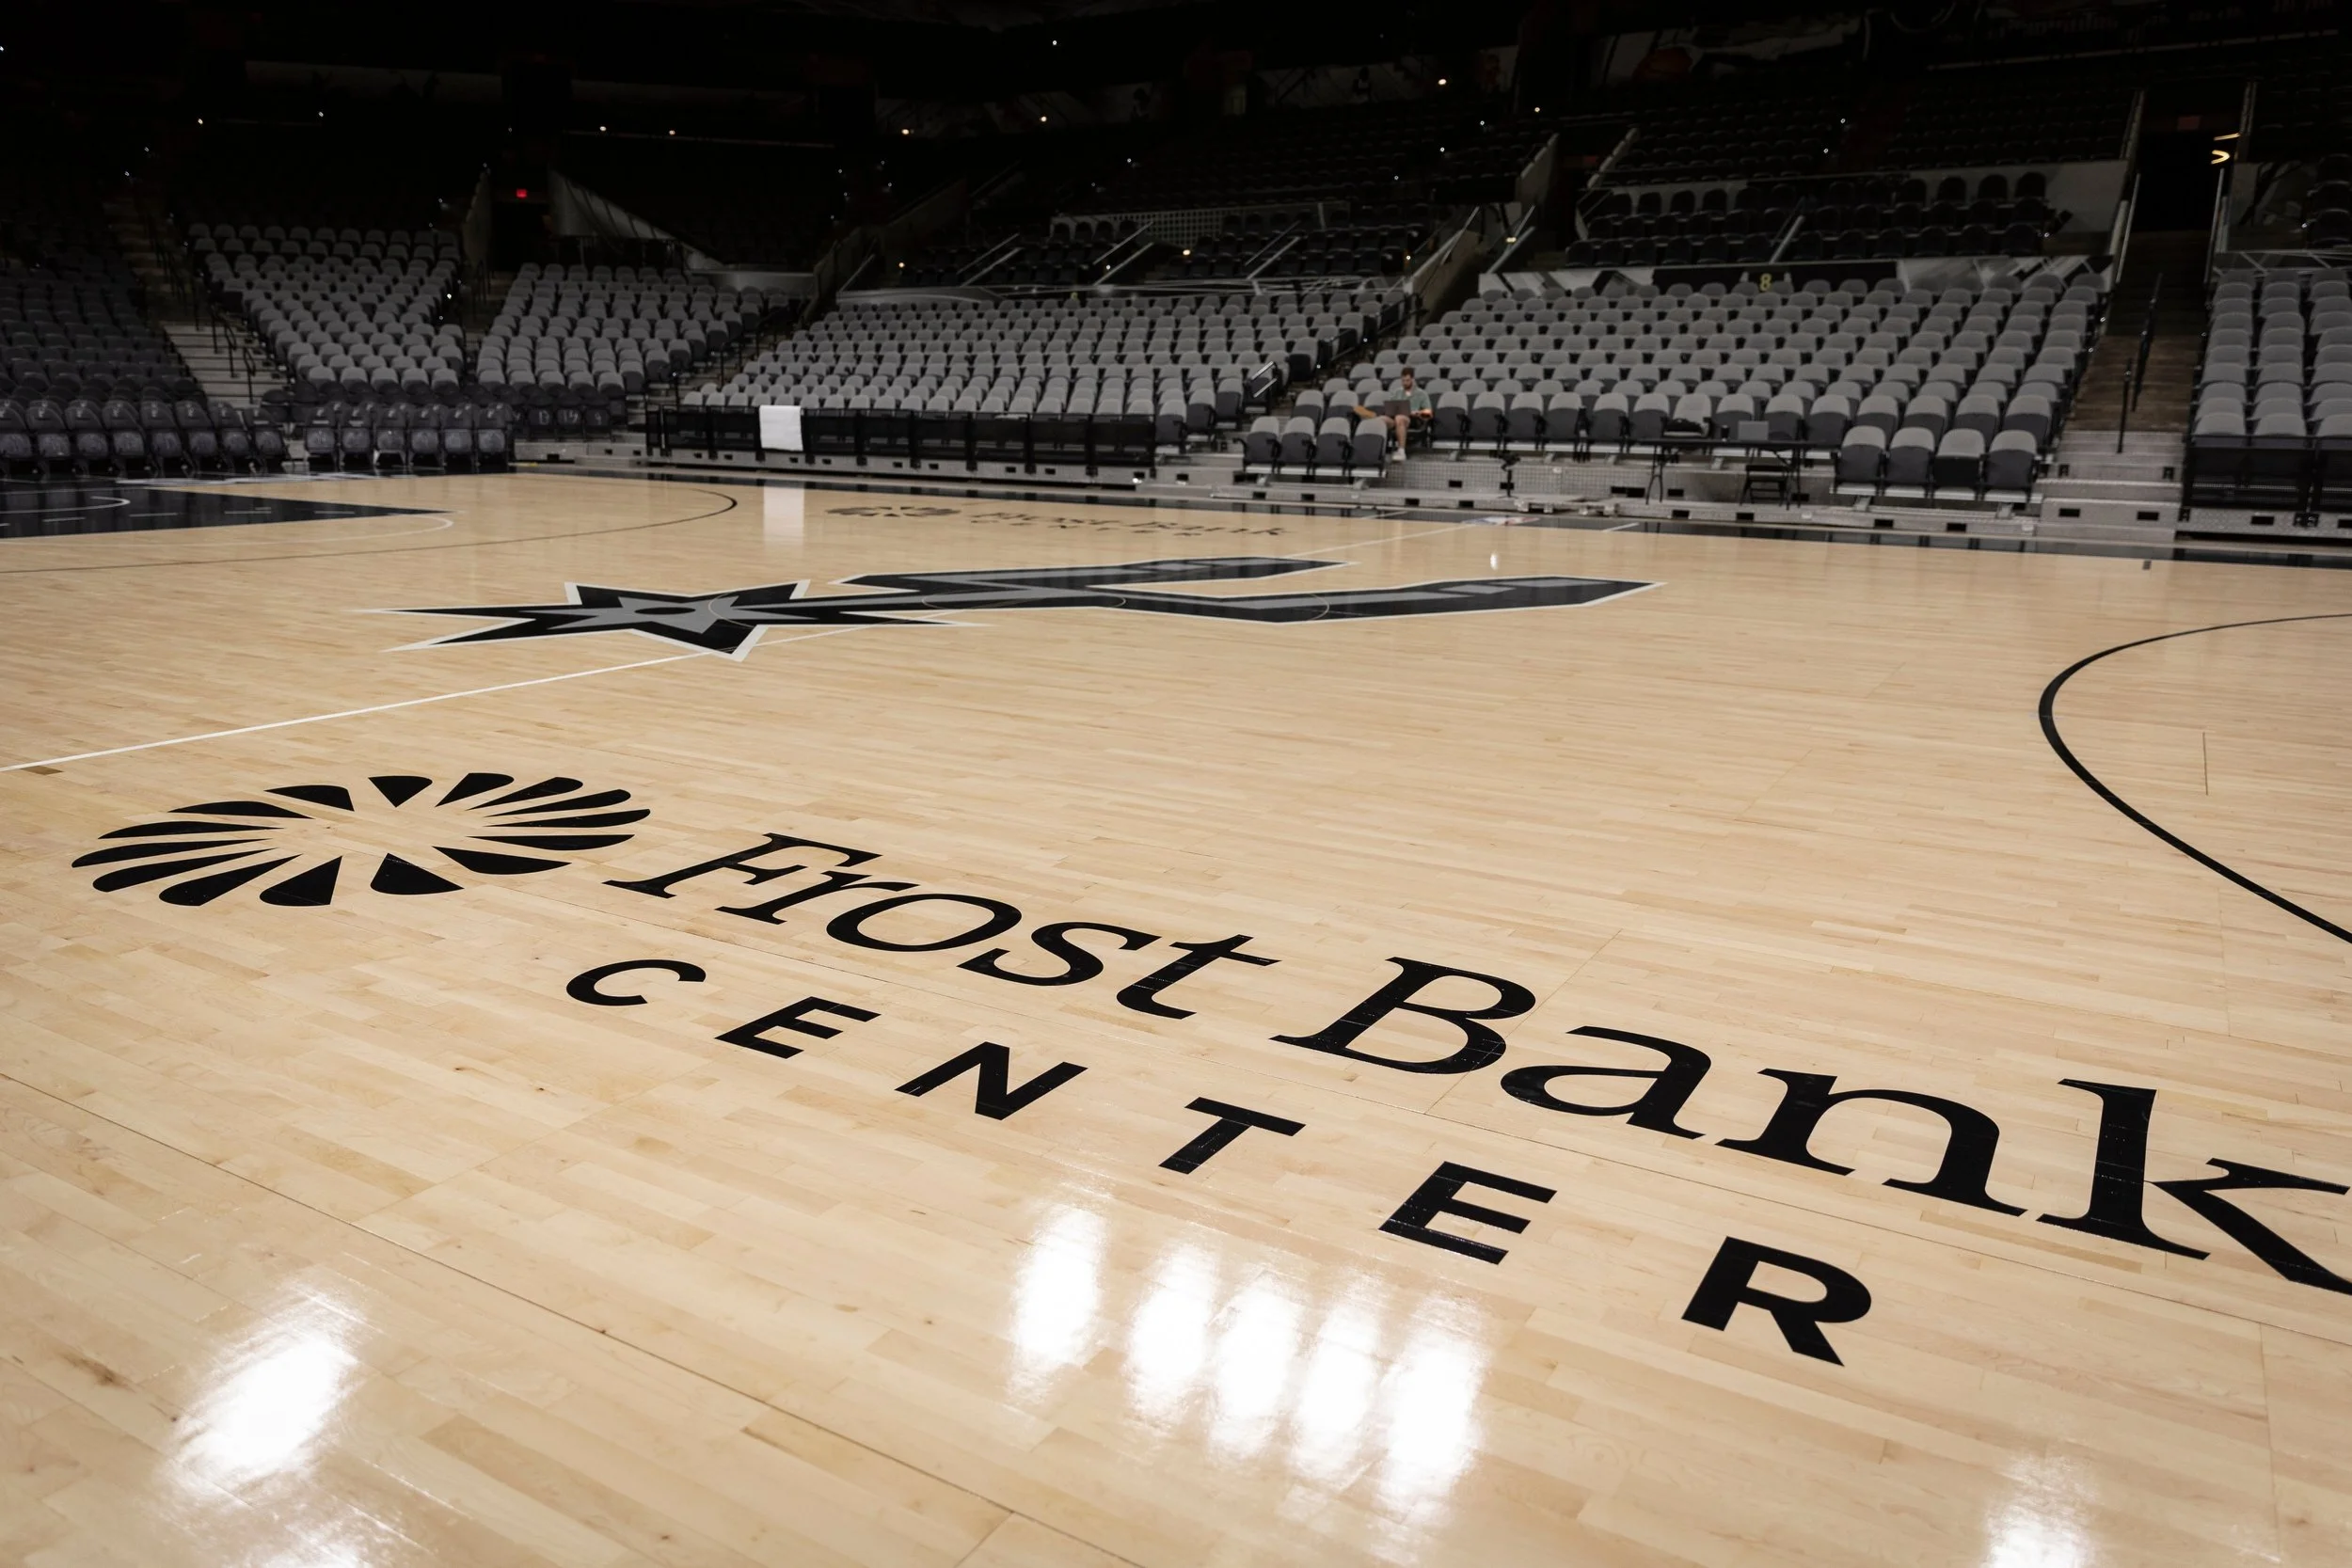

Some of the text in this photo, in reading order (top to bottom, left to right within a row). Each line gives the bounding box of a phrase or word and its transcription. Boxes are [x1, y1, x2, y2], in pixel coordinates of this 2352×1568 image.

[565, 958, 1873, 1367] CENTER
[601, 832, 2352, 1296] Frost Bank
